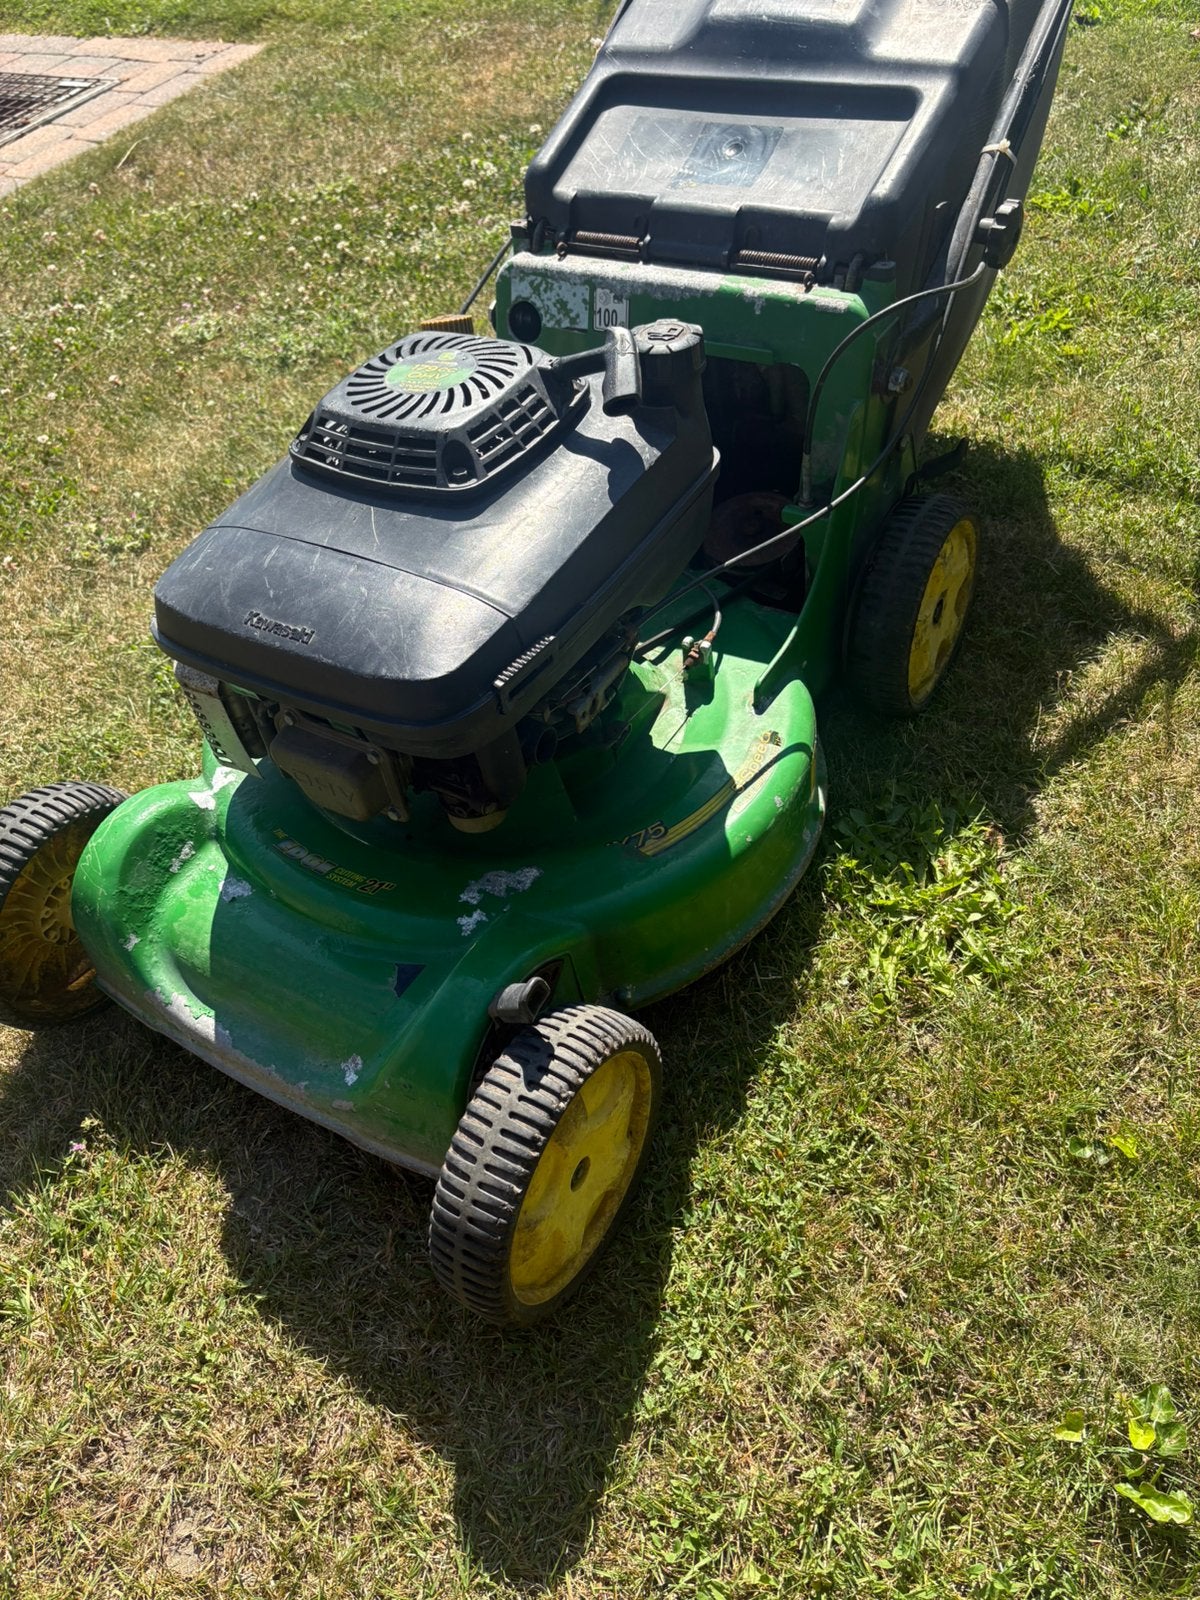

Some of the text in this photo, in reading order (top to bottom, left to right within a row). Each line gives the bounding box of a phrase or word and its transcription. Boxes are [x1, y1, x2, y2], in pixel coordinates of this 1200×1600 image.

[596, 307, 618, 327] 100
[243, 610, 316, 645] Kawasaki
[326, 872, 358, 888] SYSTEM
[357, 877, 397, 895] 21"
